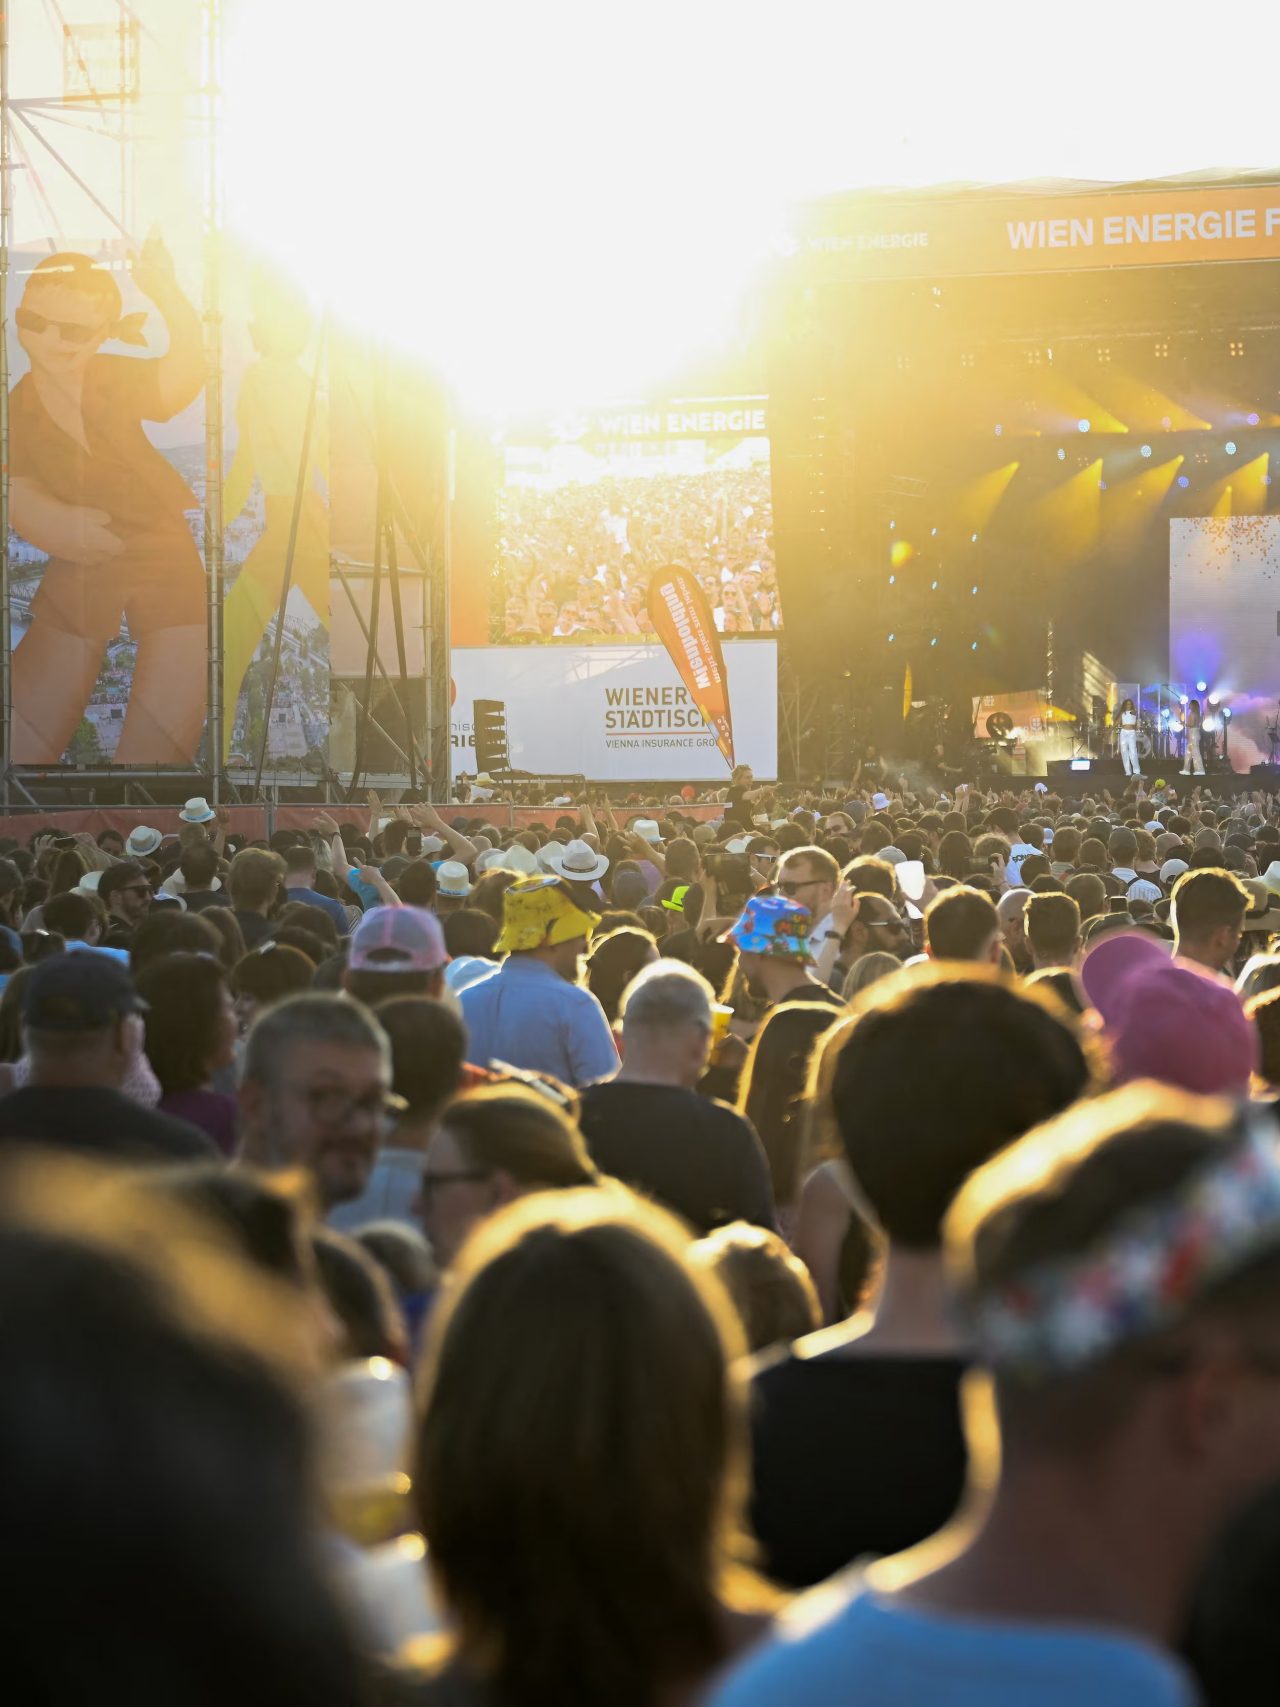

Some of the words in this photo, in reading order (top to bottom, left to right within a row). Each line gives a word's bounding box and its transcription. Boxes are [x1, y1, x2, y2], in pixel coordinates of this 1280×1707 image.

[1007, 218, 1094, 249] WIEN
[1103, 209, 1256, 246] ENERGIE
[600, 414, 661, 435] WIEN
[667, 409, 766, 433] ENERGIE
[605, 687, 688, 706] WIENER
[605, 739, 639, 749] VIENNA
[641, 738, 693, 748] INSURANCE
